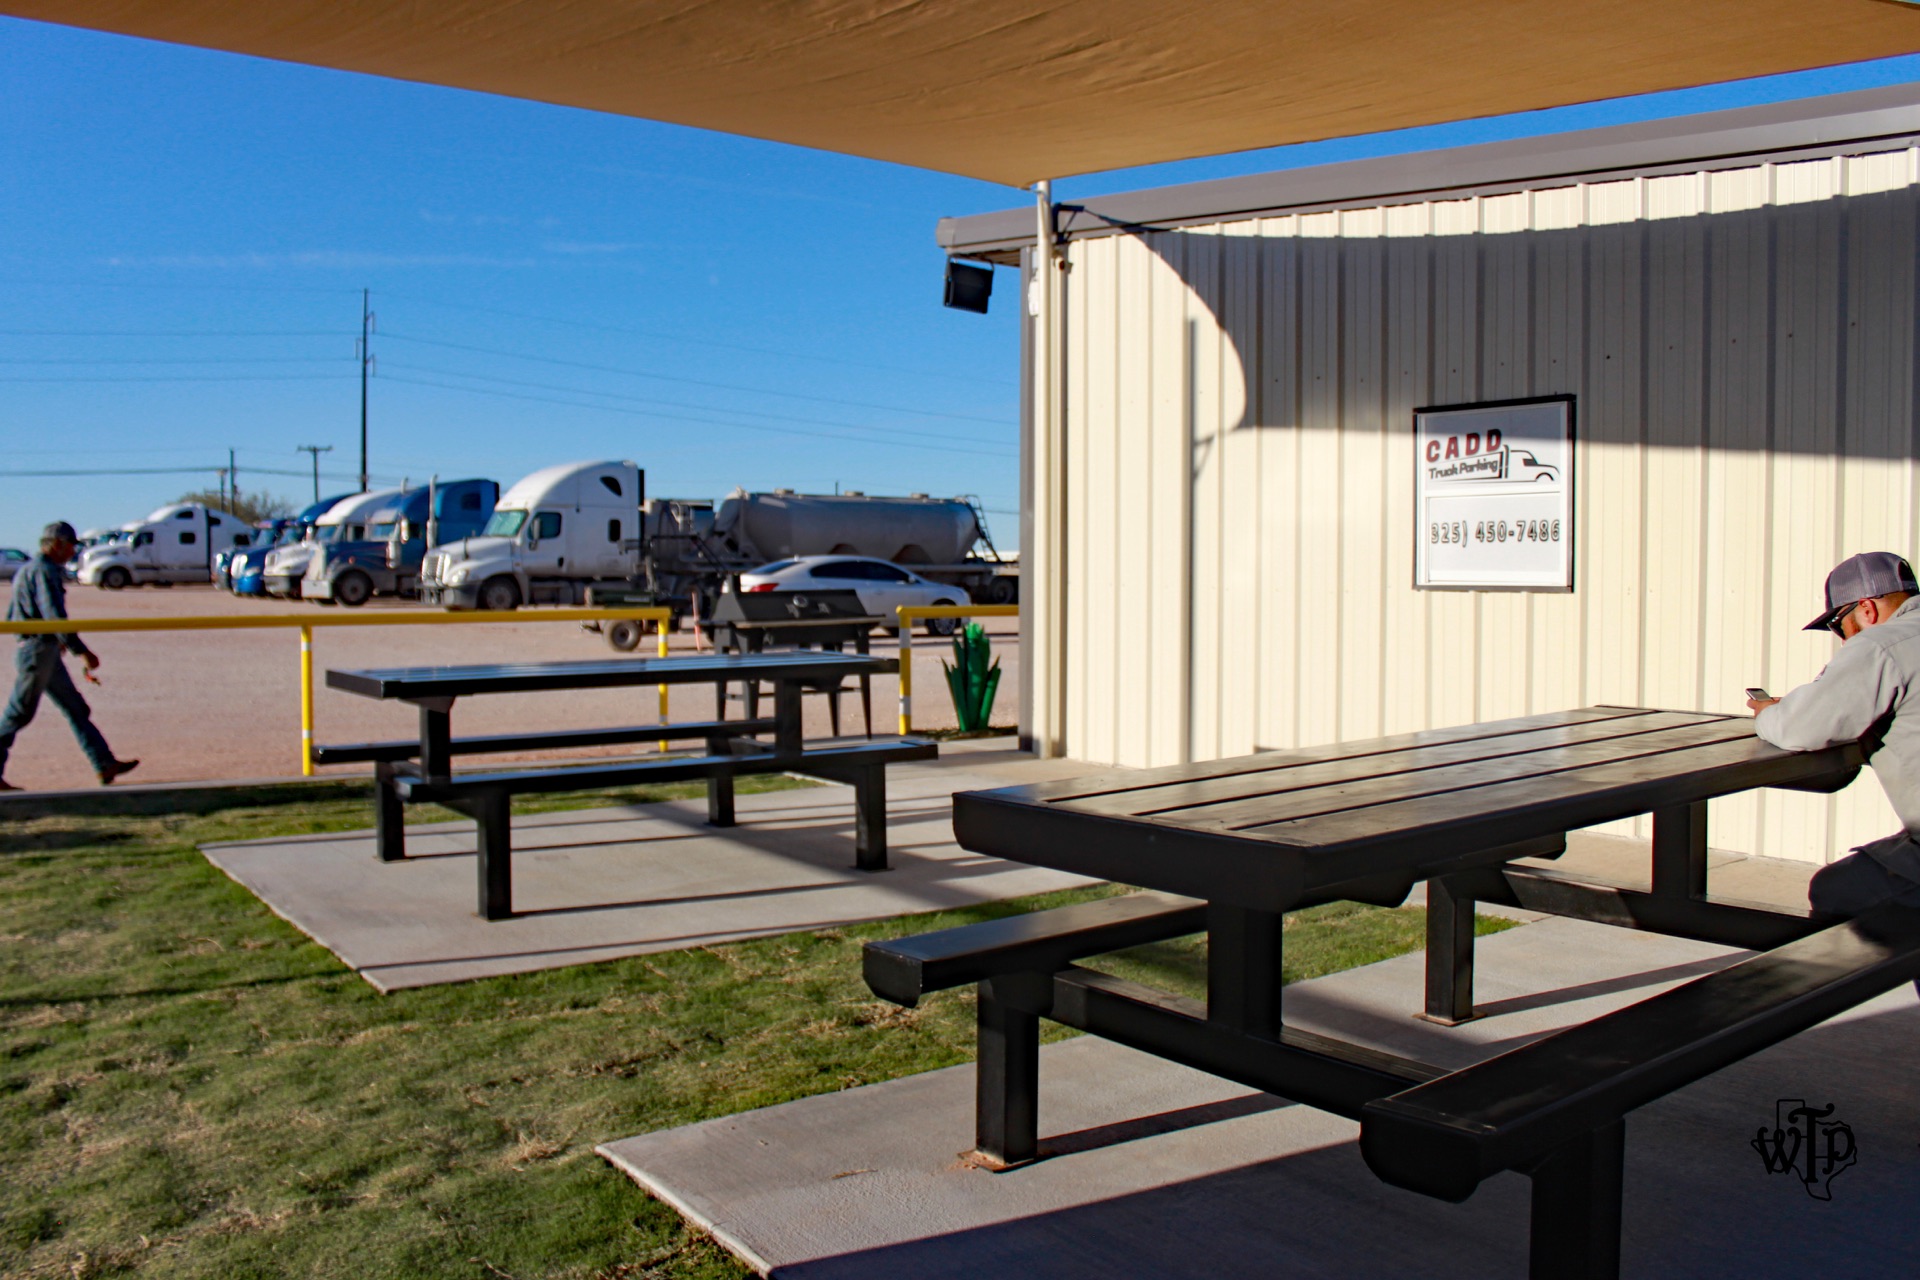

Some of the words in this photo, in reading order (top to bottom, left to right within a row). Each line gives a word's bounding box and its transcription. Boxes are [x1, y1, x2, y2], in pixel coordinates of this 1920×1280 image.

[1426, 428, 1502, 463] CADD
[1428, 464, 1458, 479] Truck
[1459, 459, 1499, 473] Parking
[1475, 519, 1560, 543] 450-7486
